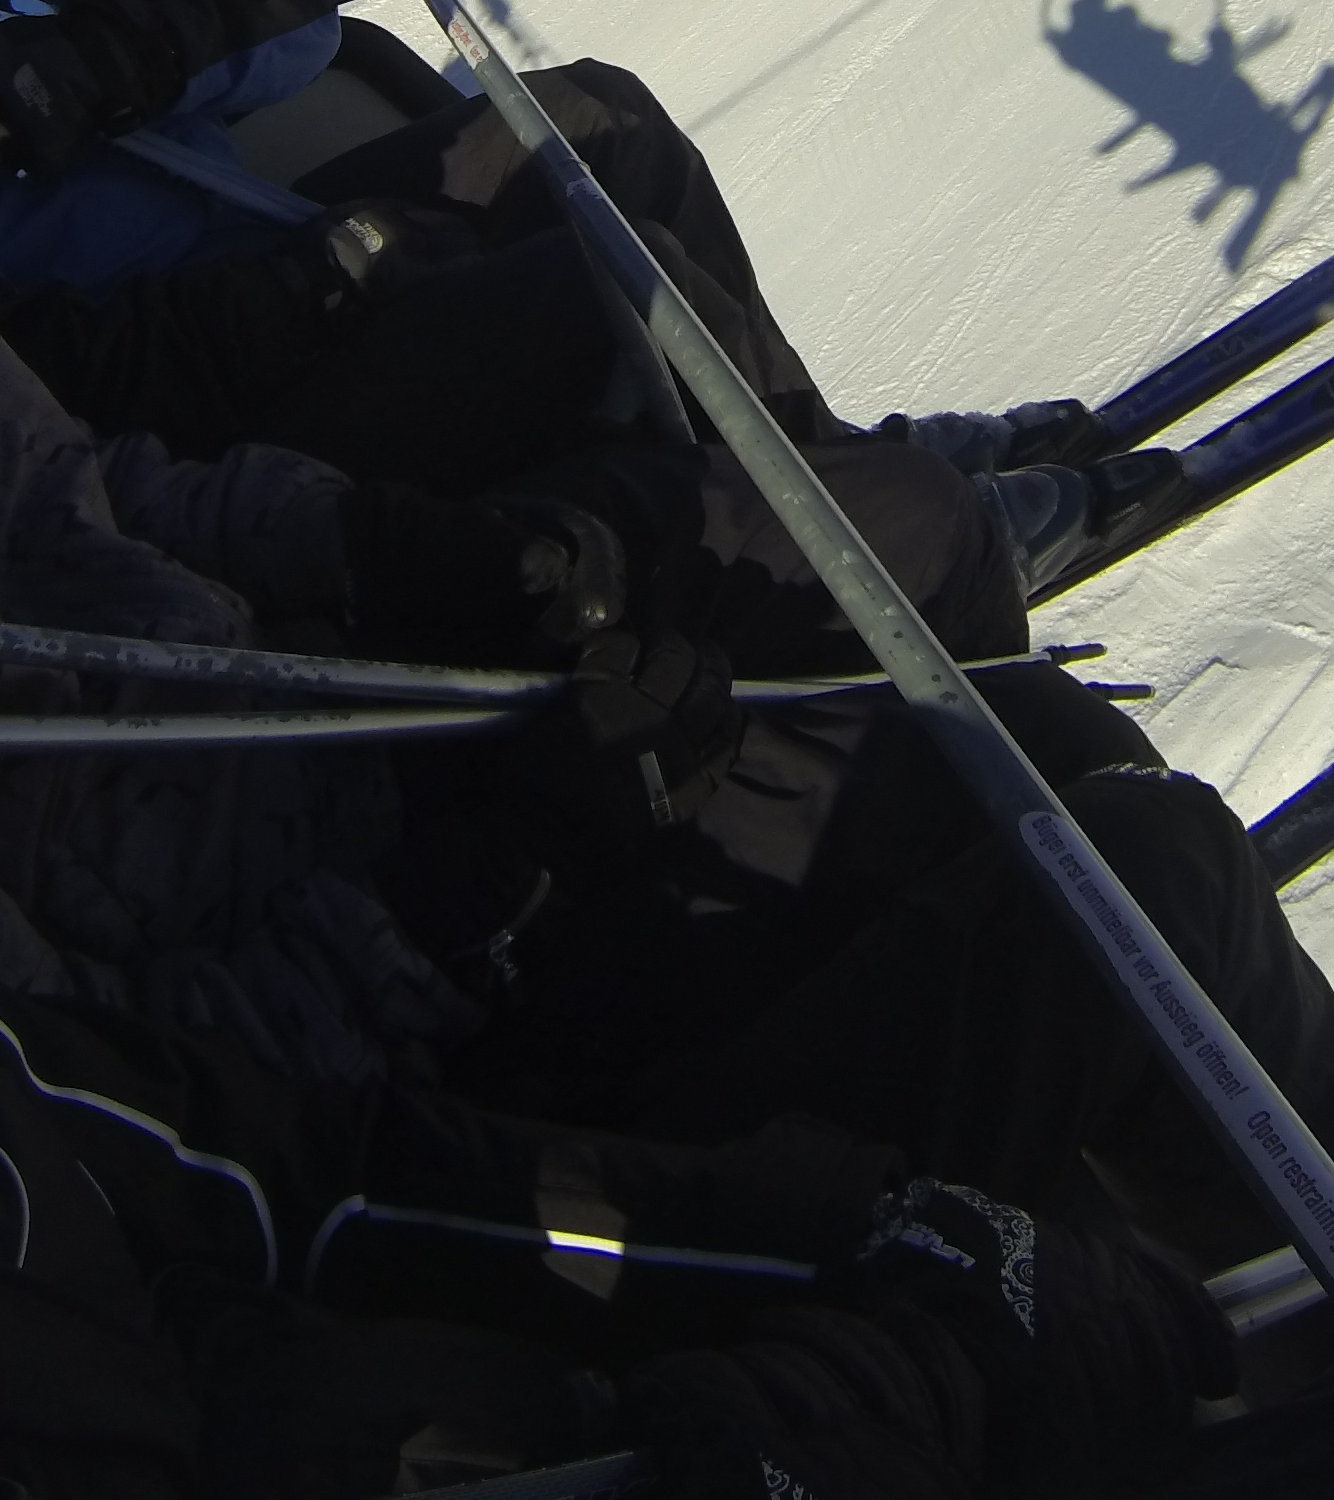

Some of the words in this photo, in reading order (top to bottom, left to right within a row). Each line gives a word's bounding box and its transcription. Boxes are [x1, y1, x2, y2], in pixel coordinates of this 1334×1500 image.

[1059, 850, 1090, 883] erst
[1134, 955, 1160, 984] vor
[1149, 978, 1207, 1049] Ausstieg
[1197, 1038, 1250, 1101] öffnen!
[1246, 1109, 1289, 1160] Open
